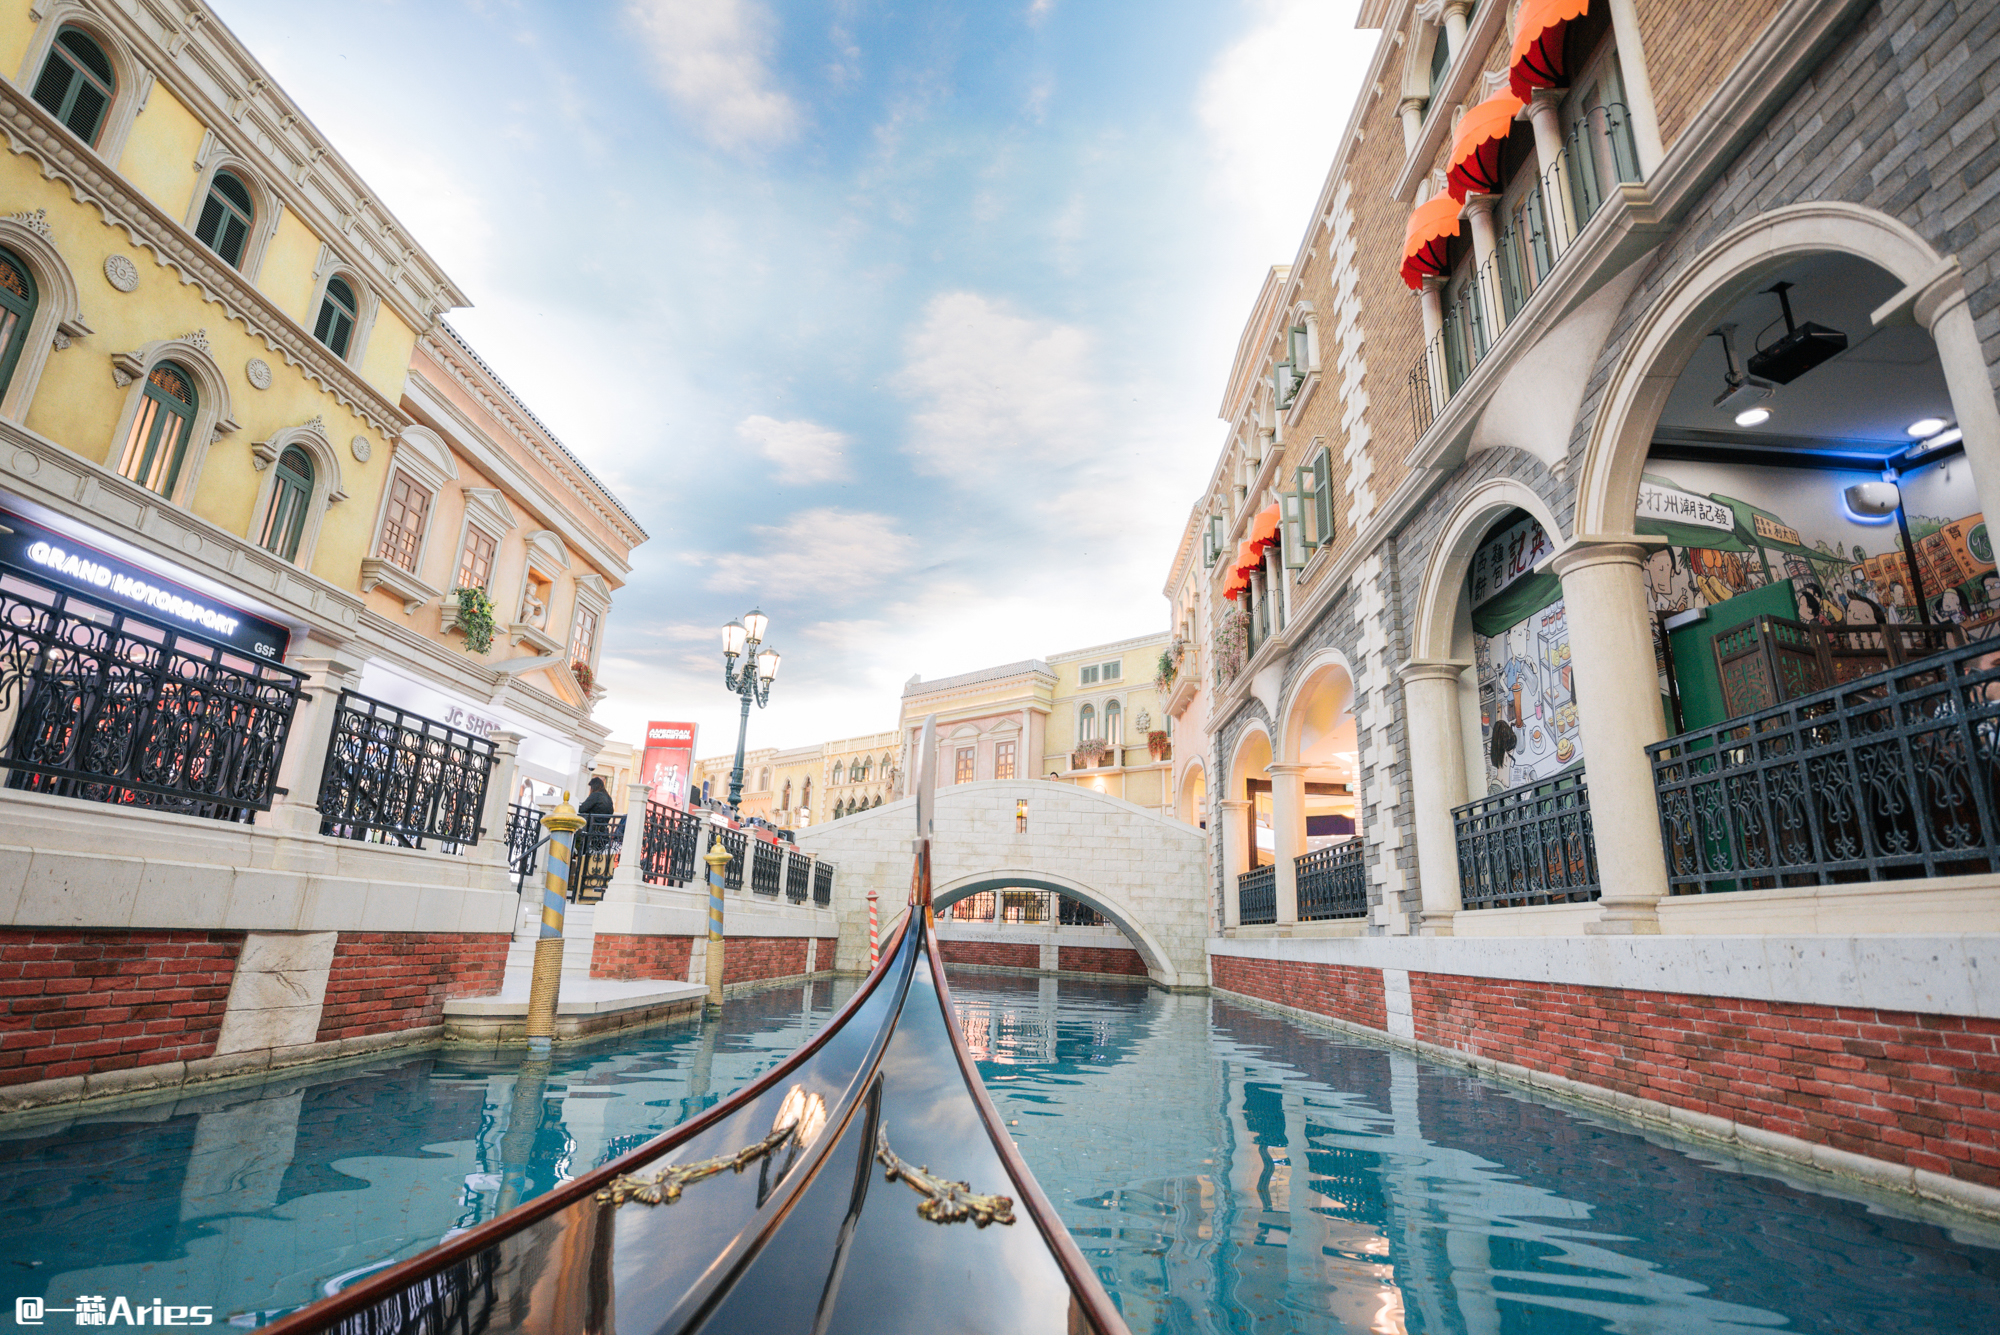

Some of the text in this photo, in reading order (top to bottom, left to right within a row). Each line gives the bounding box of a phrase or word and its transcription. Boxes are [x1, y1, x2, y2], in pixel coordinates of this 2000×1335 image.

[28, 541, 239, 636] GRAND MOTORSPORT
[254, 641, 277, 658] GSF
[444, 707, 464, 727] JC
